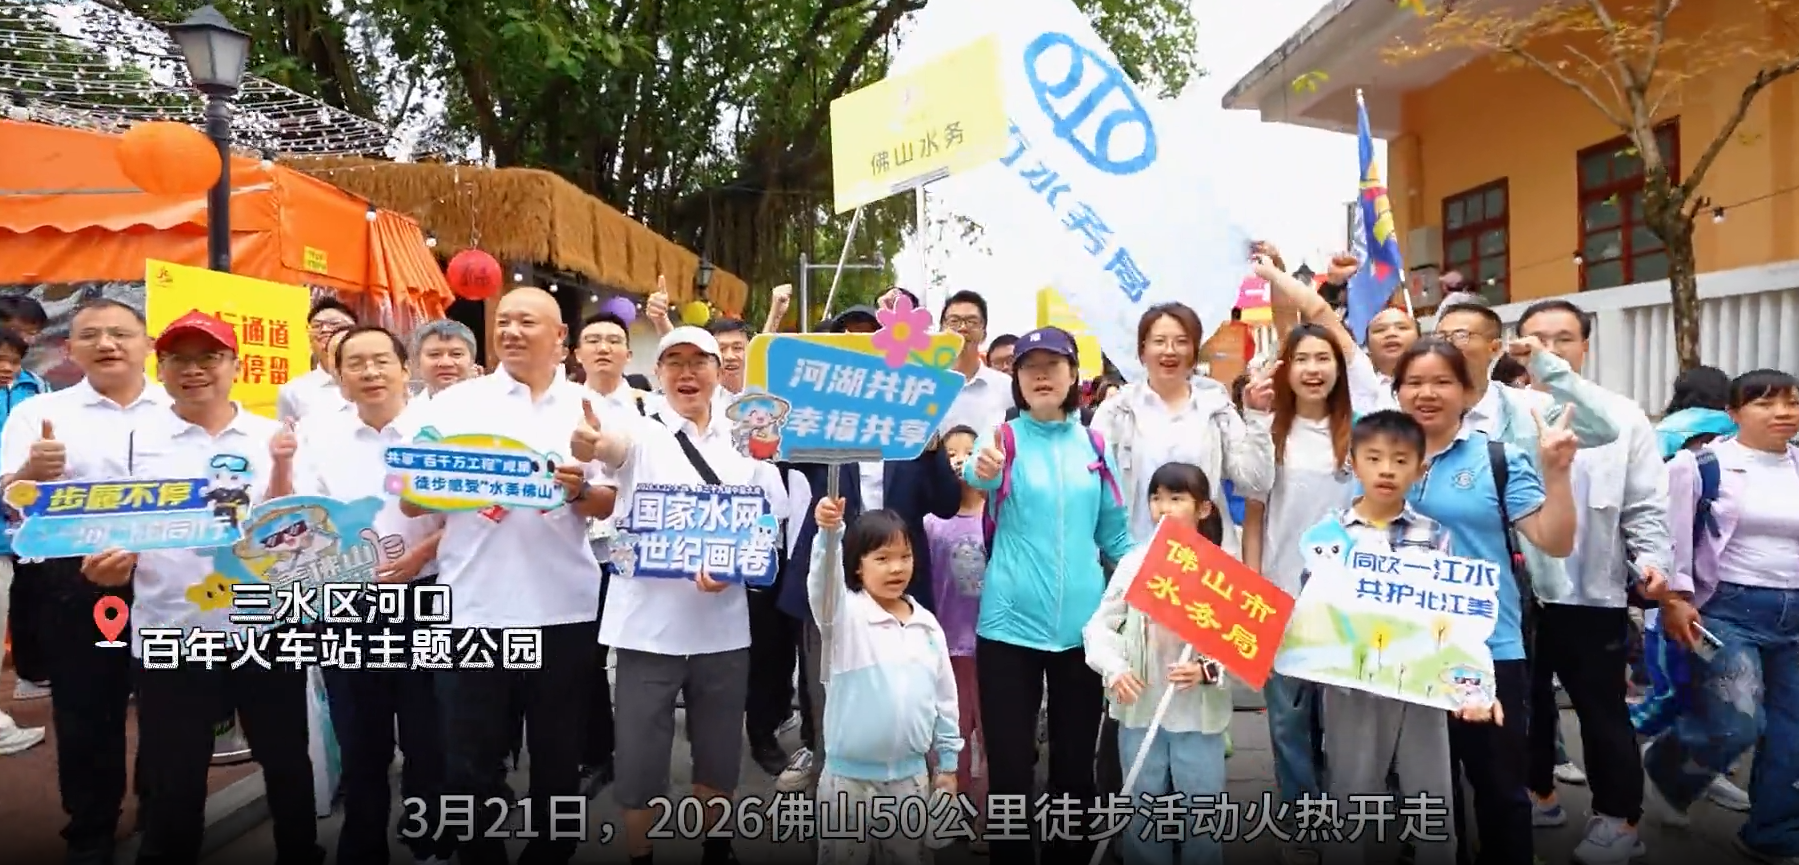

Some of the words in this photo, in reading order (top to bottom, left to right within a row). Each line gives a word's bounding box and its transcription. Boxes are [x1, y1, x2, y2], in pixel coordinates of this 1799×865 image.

[871, 121, 963, 175] 佛山水务
[789, 358, 937, 406] 河湖共护
[786, 406, 932, 447] 幸福共享
[47, 482, 194, 511] 步履不停
[633, 493, 763, 533] 国家水网
[639, 532, 771, 577] 世纪画卷
[1166, 539, 1276, 623] 佛山市
[1356, 578, 1494, 618] 共护北江美
[1147, 575, 1259, 660] 水务局
